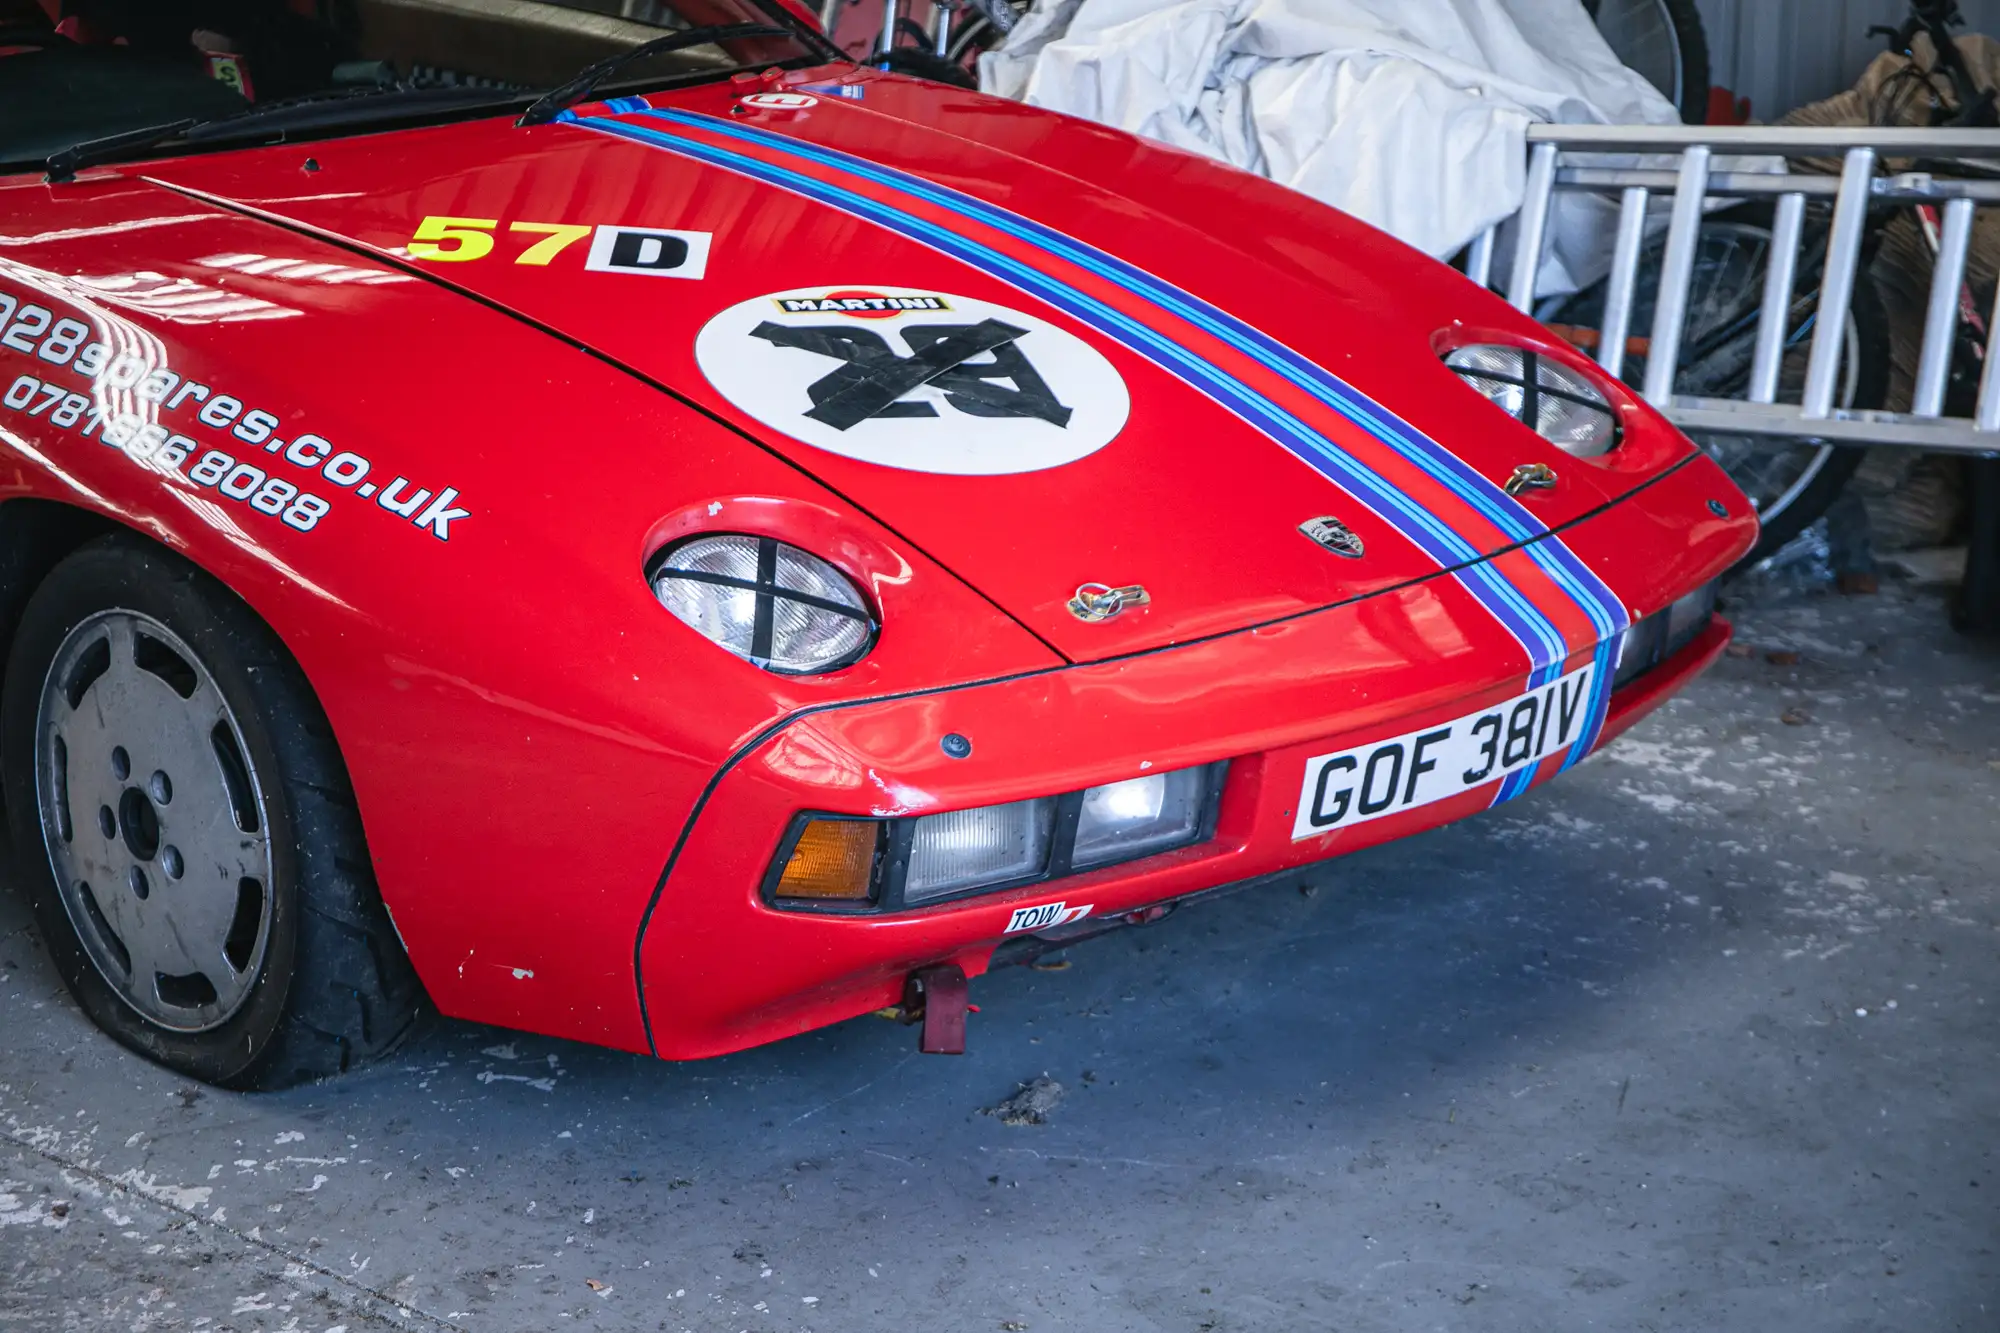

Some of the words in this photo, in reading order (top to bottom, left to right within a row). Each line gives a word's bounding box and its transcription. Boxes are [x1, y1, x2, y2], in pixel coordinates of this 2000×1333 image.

[785, 297, 940, 312] MARTINI
[188, 449, 332, 533] 8088
[1310, 726, 1453, 828] GOF
[1462, 670, 1588, 785] 381V
[1011, 904, 1063, 931] TOW
